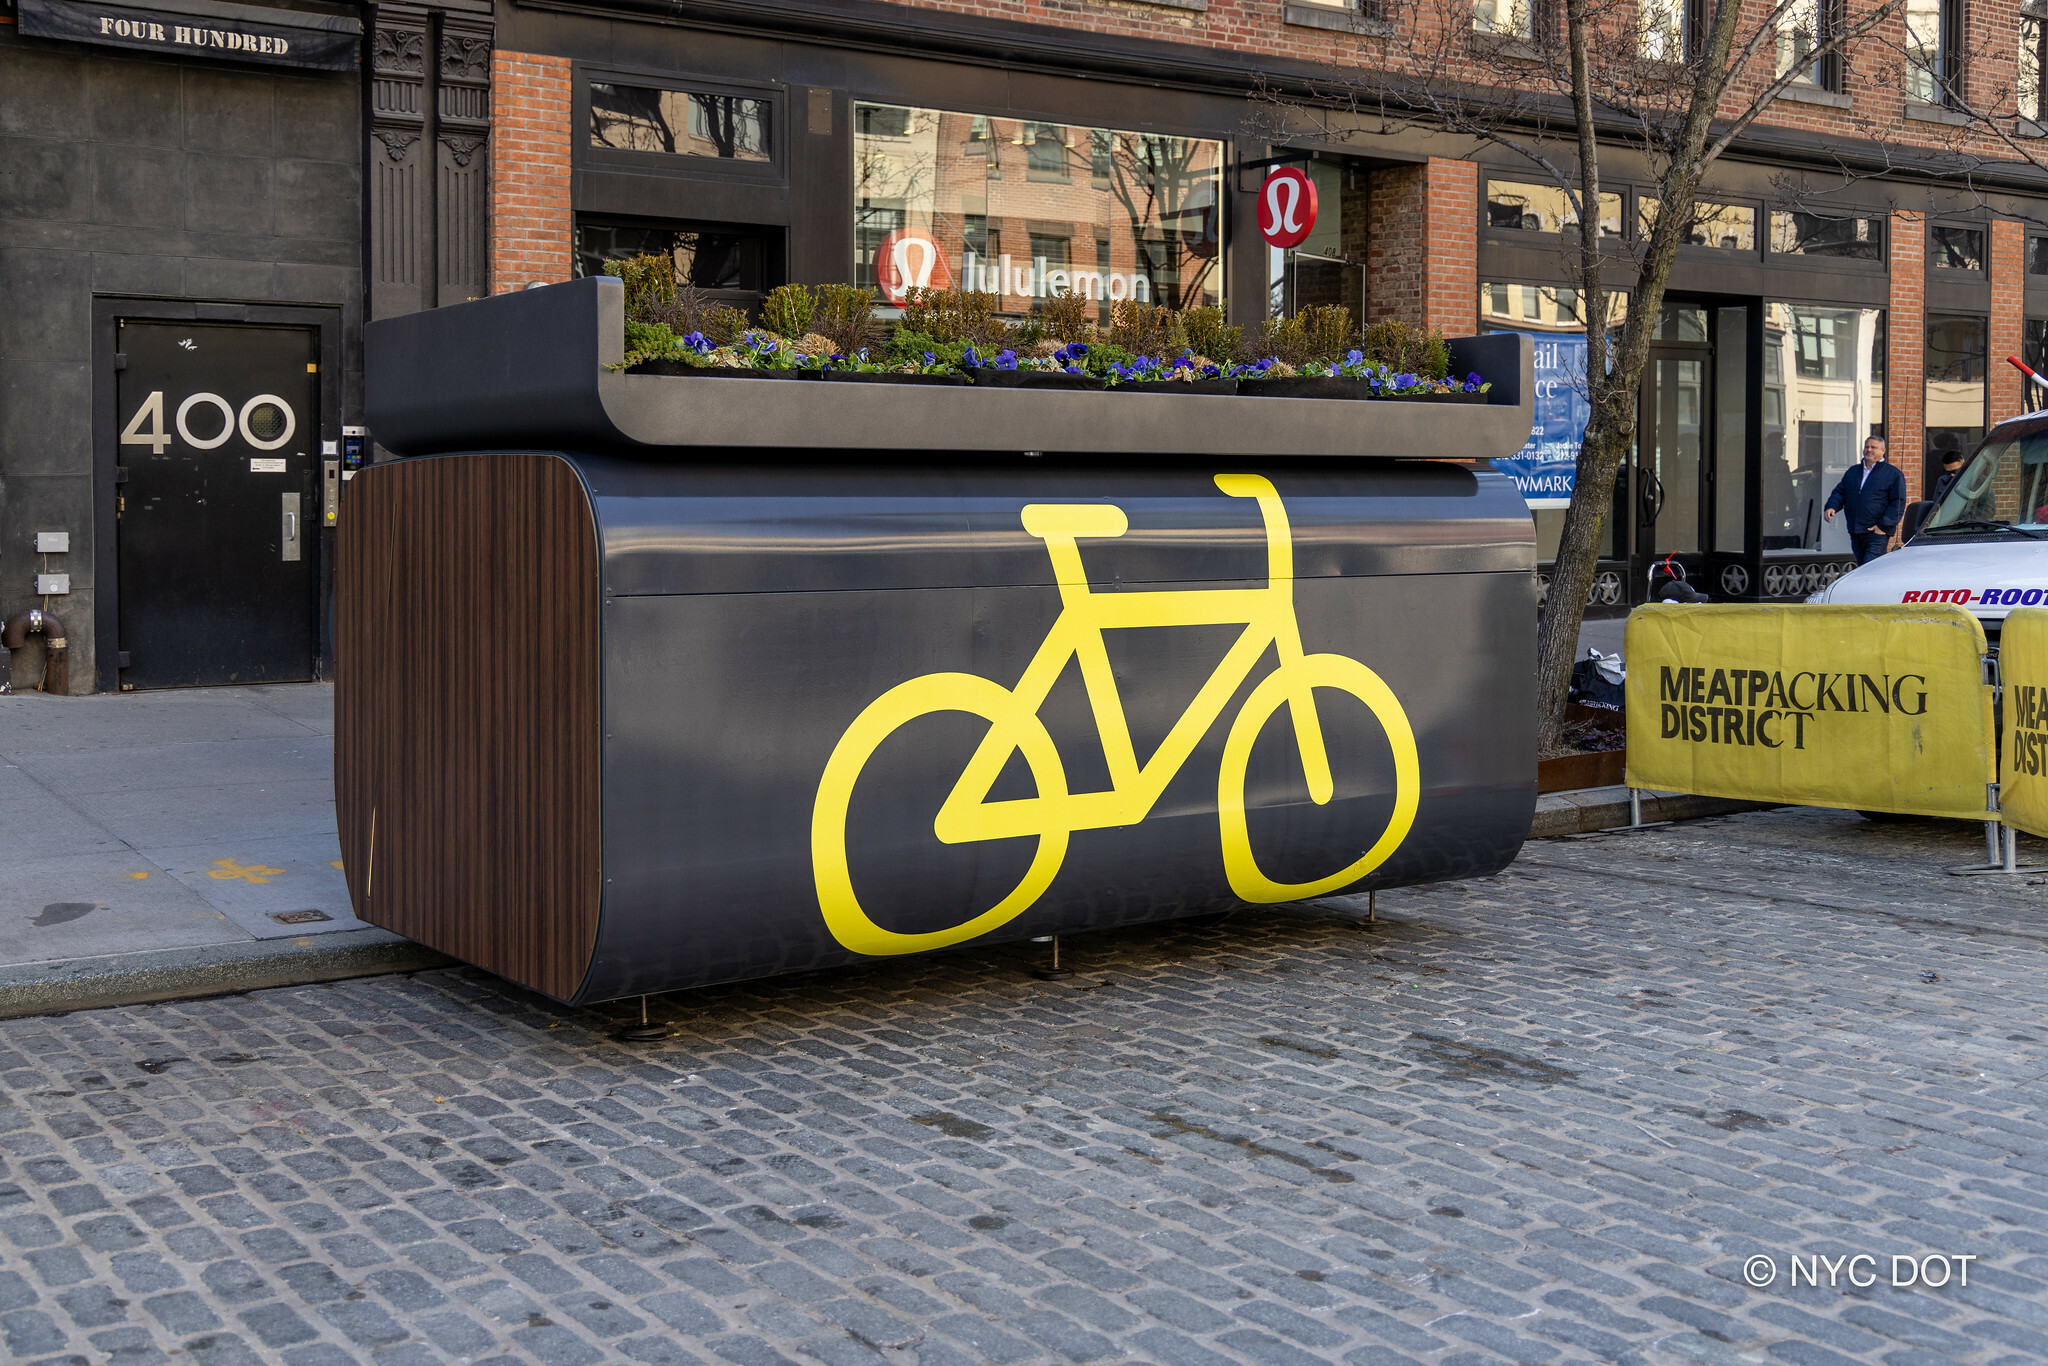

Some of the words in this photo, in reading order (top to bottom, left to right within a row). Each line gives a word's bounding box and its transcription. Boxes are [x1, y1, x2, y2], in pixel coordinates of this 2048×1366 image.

[100, 17, 166, 41] FOUR
[174, 26, 289, 55] HUNDRED
[962, 251, 1150, 303] lululemon
[1533, 343, 1558, 369] ail
[1534, 380, 1558, 399] ce
[120, 391, 296, 455] 400
[1508, 475, 1573, 492] WMARK
[1660, 665, 1928, 716] MEATPACKING
[1660, 703, 1816, 750] DISTRICT
